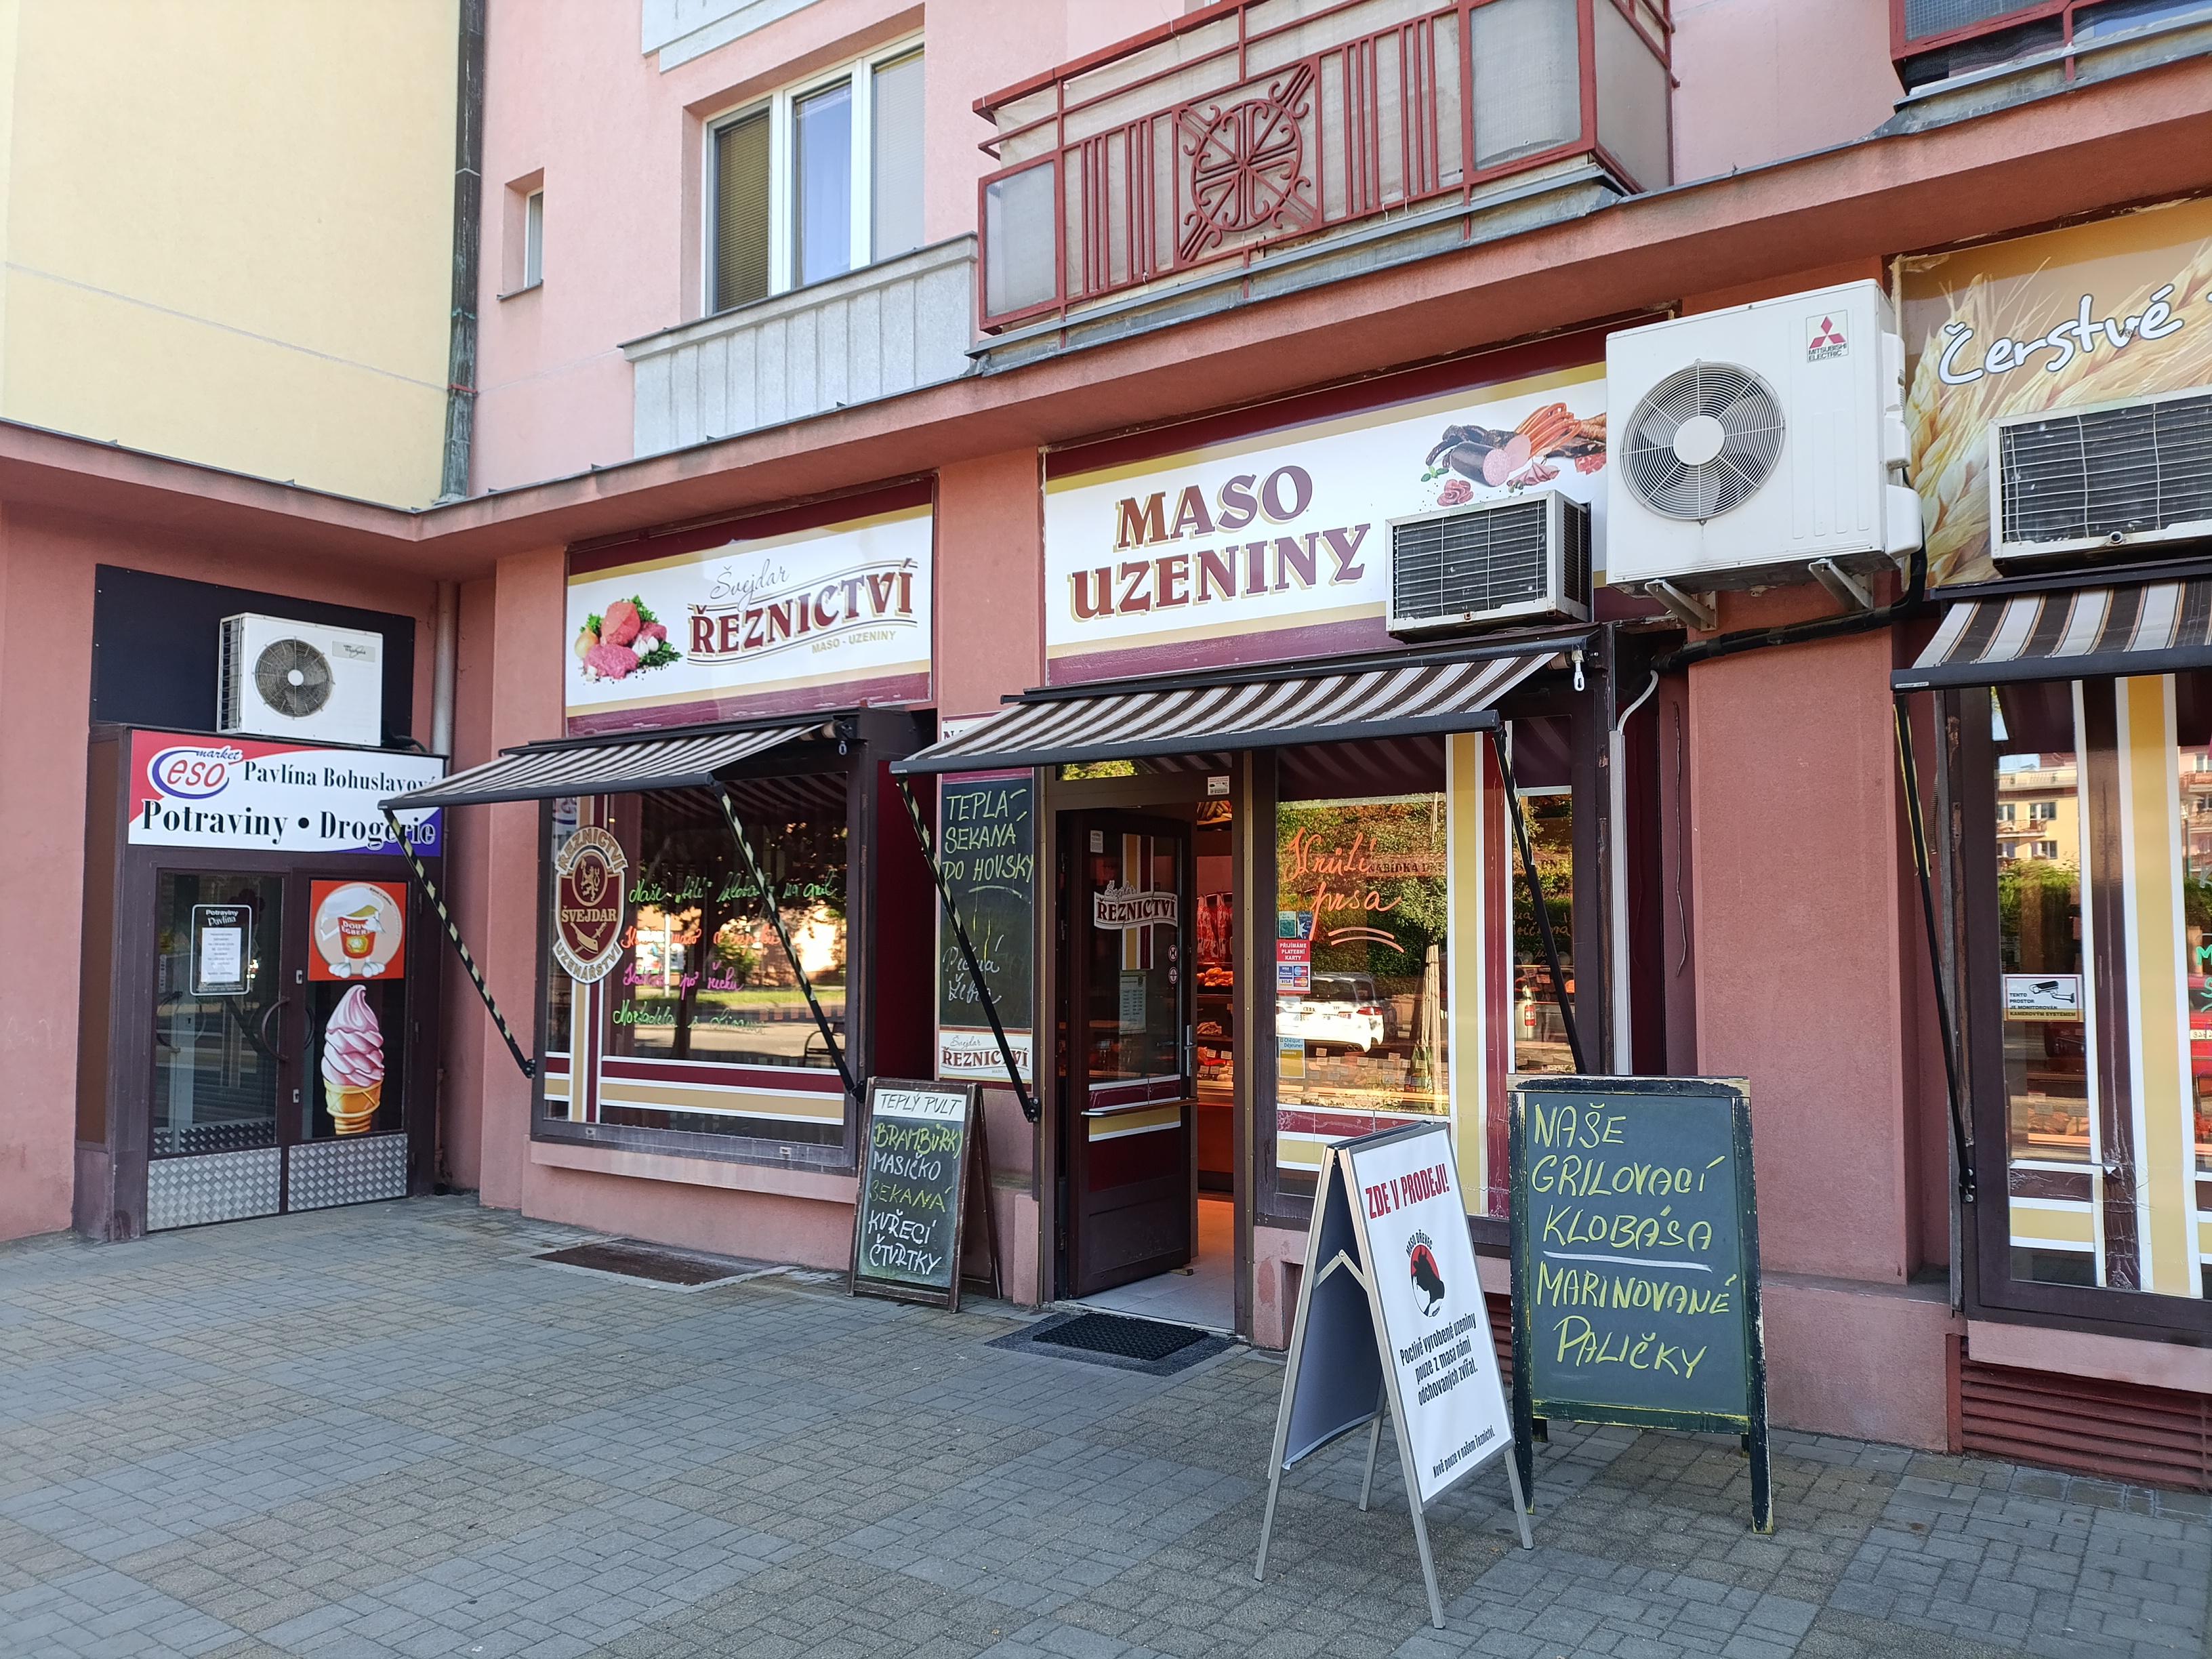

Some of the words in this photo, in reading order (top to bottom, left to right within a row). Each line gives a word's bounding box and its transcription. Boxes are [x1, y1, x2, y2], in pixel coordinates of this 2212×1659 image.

[1808, 343, 1847, 355] MITSUBISHI
[1939, 284, 2184, 385] Čerstvé
[1809, 350, 1842, 361] ELECTRIC
[1113, 466, 1313, 553] MASO
[710, 558, 790, 613] Švejdar
[1067, 523, 1372, 622] UZENINY
[689, 558, 914, 657] ŘEZNICTVÍ
[811, 639, 840, 654] MASO
[848, 630, 897, 645] UZENINY
[167, 759, 225, 787] eso
[197, 748, 239, 760] market
[243, 761, 317, 785] Pavlína
[323, 766, 436, 792] Bohuslavov
[142, 800, 289, 845] Potraviny
[942, 860, 964, 881] DO
[205, 909, 239, 917] Potraviny
[561, 905, 617, 922] ŠVEJDAR
[1097, 895, 1176, 922] ŘEZNICTVÍ
[1309, 882, 1403, 941] prsa
[942, 1046, 1029, 1067] ŘEZNICVÍ
[924, 1097, 962, 1116] PULT
[1534, 1102, 1626, 1149] NAŠE
[1365, 1183, 1391, 1220] ZDE
[1389, 1179, 1400, 1210] V
[1400, 1163, 1450, 1207] PRODEJI!
[1532, 1154, 1726, 1197] GRILOVACÍ
[1405, 1235, 1416, 1258] MASO
[1416, 1229, 1433, 1250] DŘEVEC
[1542, 1204, 1713, 1252] KLOBÁSA
[1536, 1260, 1738, 1315] MARINOVANÉ
[1399, 1336, 1424, 1367] Poctivě
[1423, 1321, 1454, 1353] vyrobené
[1453, 1313, 1477, 1336] uzeniny
[1415, 1359, 1434, 1385] pouze
[1433, 1357, 1440, 1372] z
[1439, 1347, 1456, 1369] masa
[1456, 1335, 1472, 1358] námi
[1553, 1315, 1707, 1379] PALIČKY
[1418, 1368, 1460, 1406] odchovaných
[1444, 1452, 1458, 1472] pouze
[1460, 1441, 1477, 1458] našem
